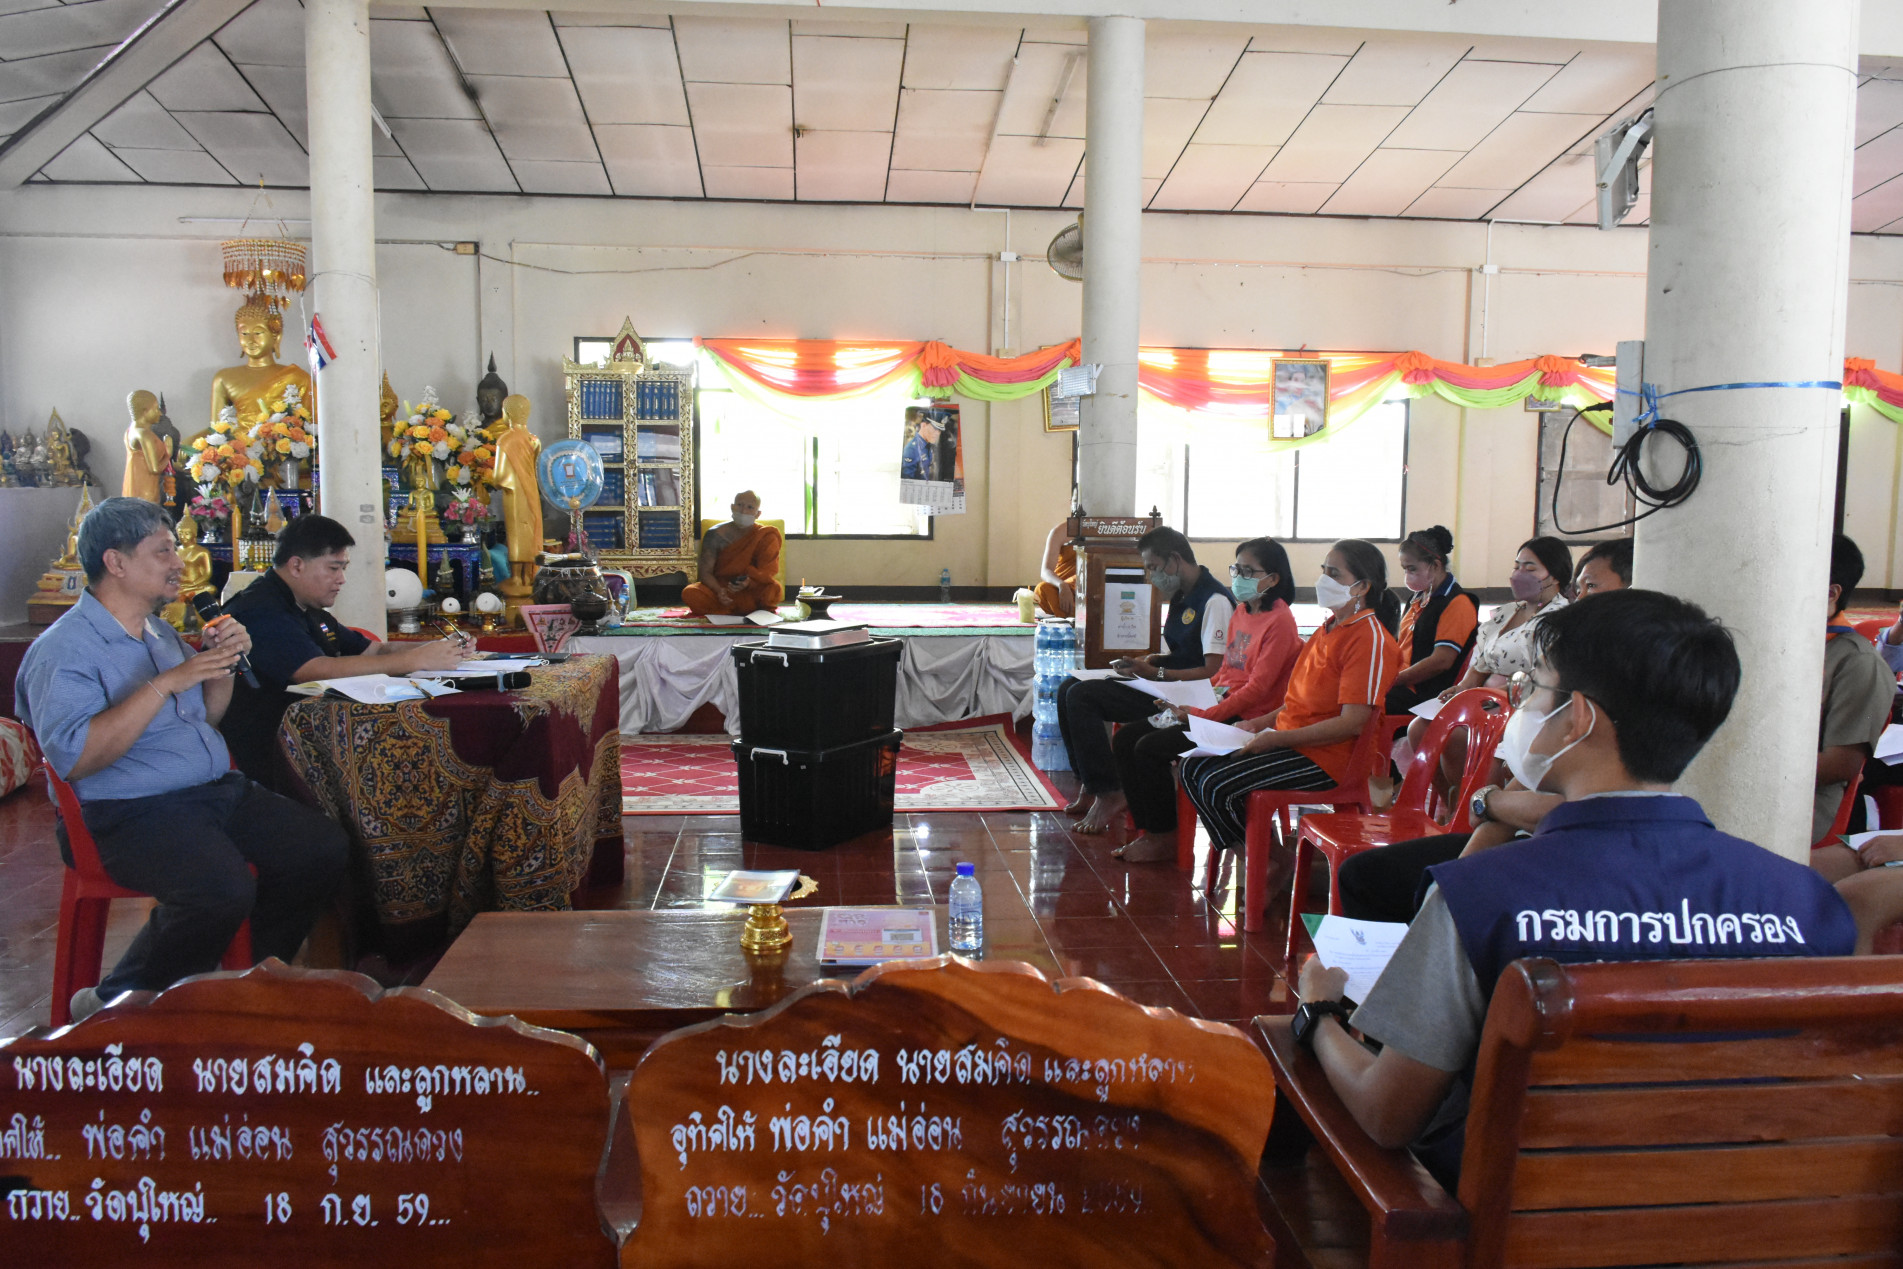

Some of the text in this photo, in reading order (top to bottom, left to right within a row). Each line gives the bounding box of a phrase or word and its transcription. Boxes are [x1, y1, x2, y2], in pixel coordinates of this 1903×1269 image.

[1097, 520, 1147, 534] ยินดีต้อนรับ
[1516, 898, 1806, 944] กรมการปกครอง
[14, 1042, 164, 1092] นางละเอียด
[193, 1042, 342, 1095] นายสมคิด
[715, 1033, 880, 1085] นางละเอียด
[896, 1037, 1032, 1087] นายสมคิด
[82, 1107, 166, 1161] พ่อคำ
[189, 1113, 293, 1161] แม่อ่อน
[321, 1120, 463, 1186] สุวรรณดวง
[670, 1105, 758, 1171] อุทิศให้
[769, 1097, 850, 1152] พ่อคำ
[867, 1100, 962, 1151] แม่อ่อน
[264, 1192, 292, 1225] 18
[920, 1182, 944, 1215] 18
